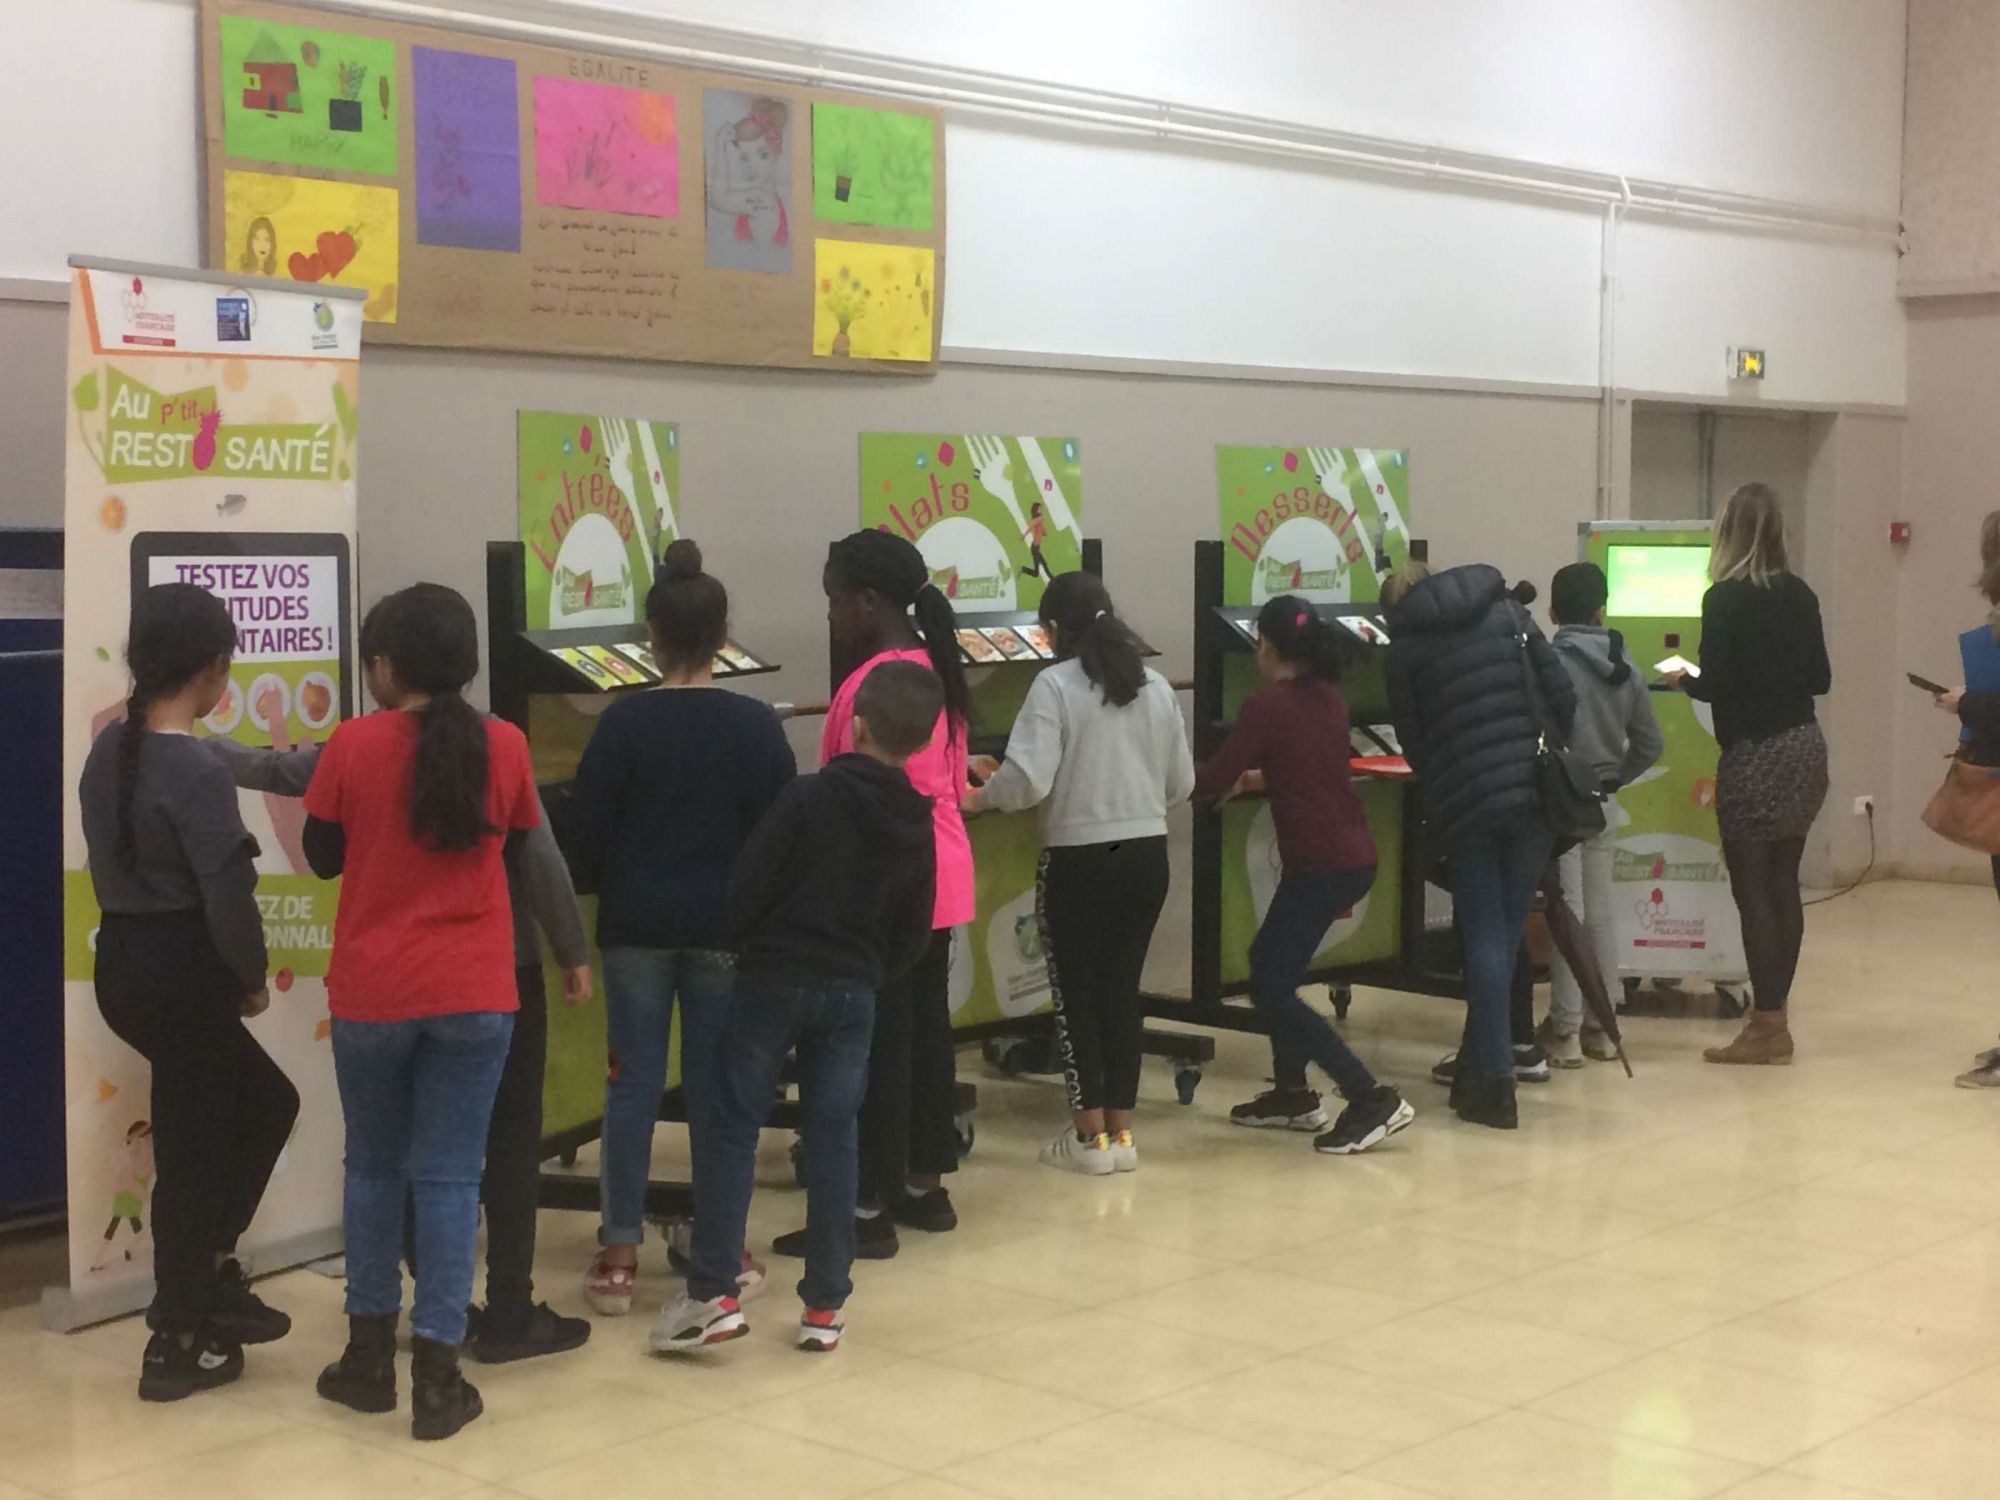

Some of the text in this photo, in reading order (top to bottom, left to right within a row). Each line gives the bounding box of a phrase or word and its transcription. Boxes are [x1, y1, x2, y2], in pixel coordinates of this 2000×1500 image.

[225, 423, 330, 474] SANTÉ
[877, 472, 970, 542] lats
[1230, 486, 1364, 564] Desserts
[176, 563, 310, 590] TESTEZ VOS
[228, 596, 309, 622] ITUDES
[235, 627, 323, 654] NTAIRES
[284, 896, 313, 920] DE
